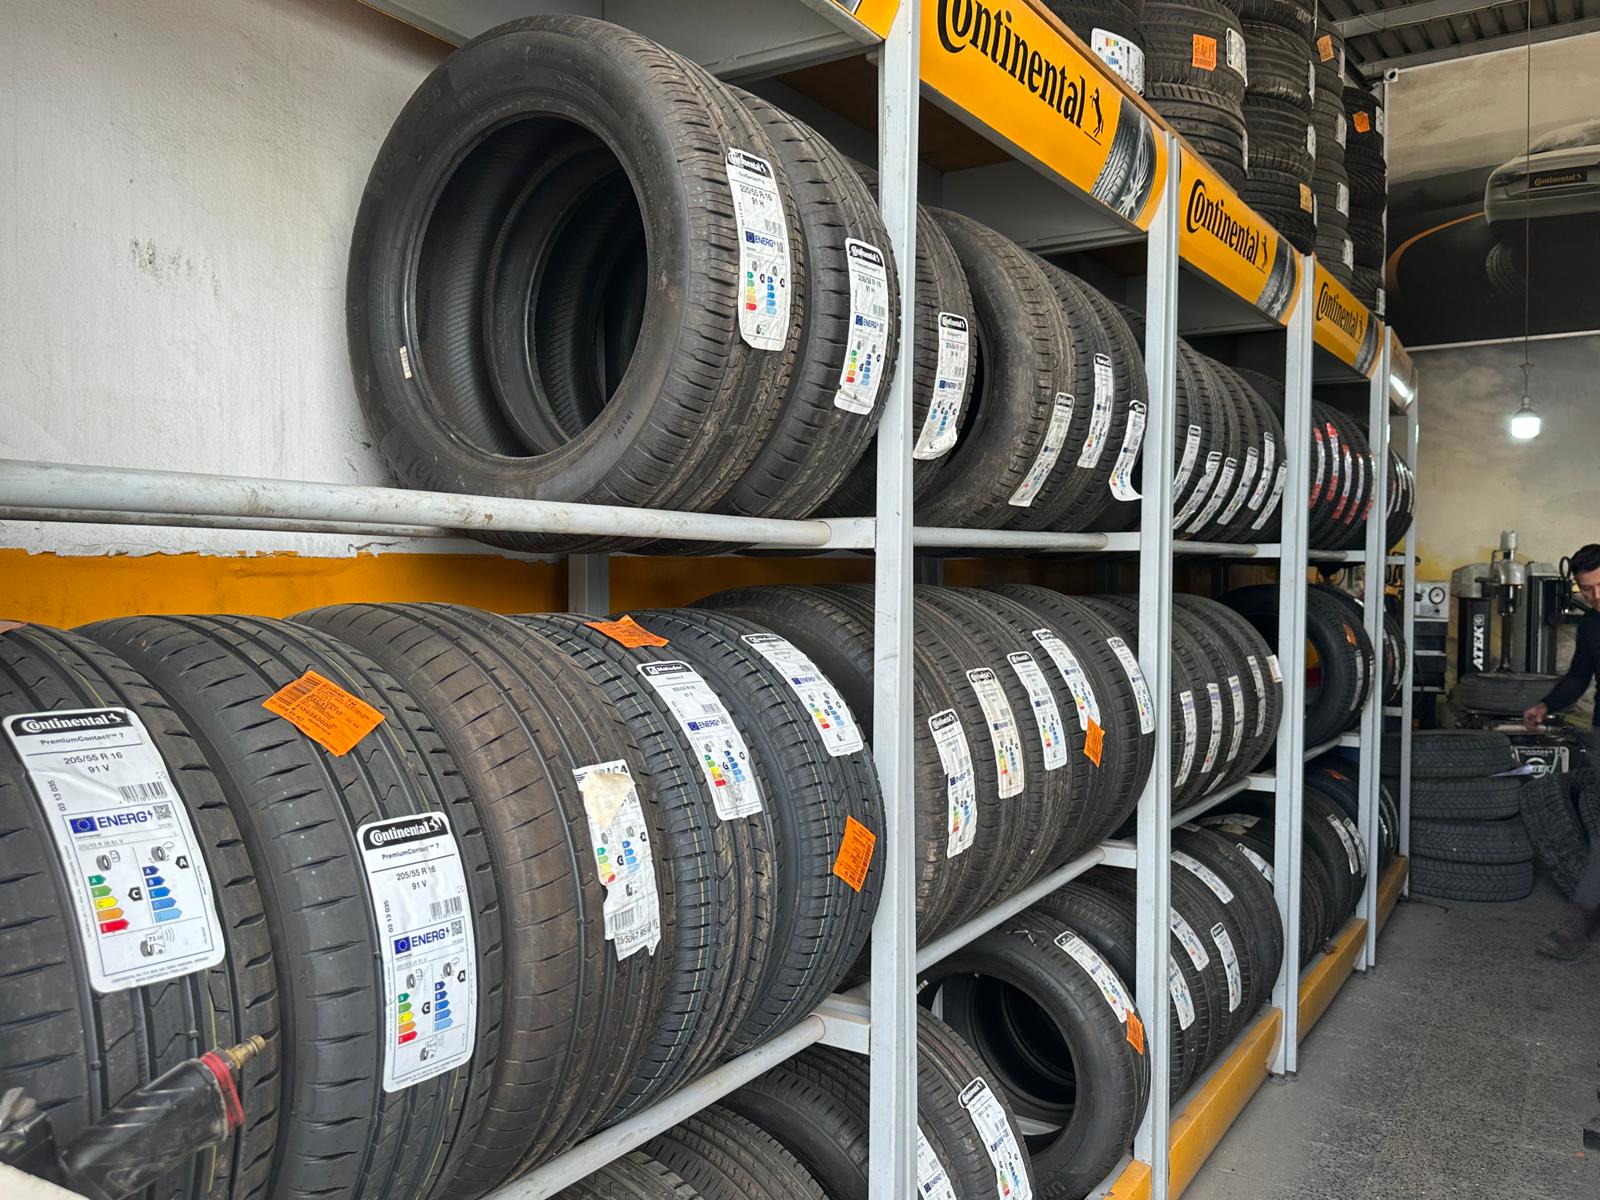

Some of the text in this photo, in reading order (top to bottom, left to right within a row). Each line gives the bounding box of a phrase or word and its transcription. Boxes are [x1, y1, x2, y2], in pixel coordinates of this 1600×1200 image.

[937, 0, 1087, 130] Continental
[1535, 173, 1576, 187] Continental
[1186, 179, 1260, 266] Continental
[1316, 282, 1358, 340] Continental
[21, 714, 110, 733] Continental
[63, 752, 123, 765] 205/55 R 16
[88, 764, 110, 774] 91 V
[369, 821, 431, 846] Continental
[396, 865, 437, 881] 205/55 R 16
[411, 880, 428, 890] 91 V
